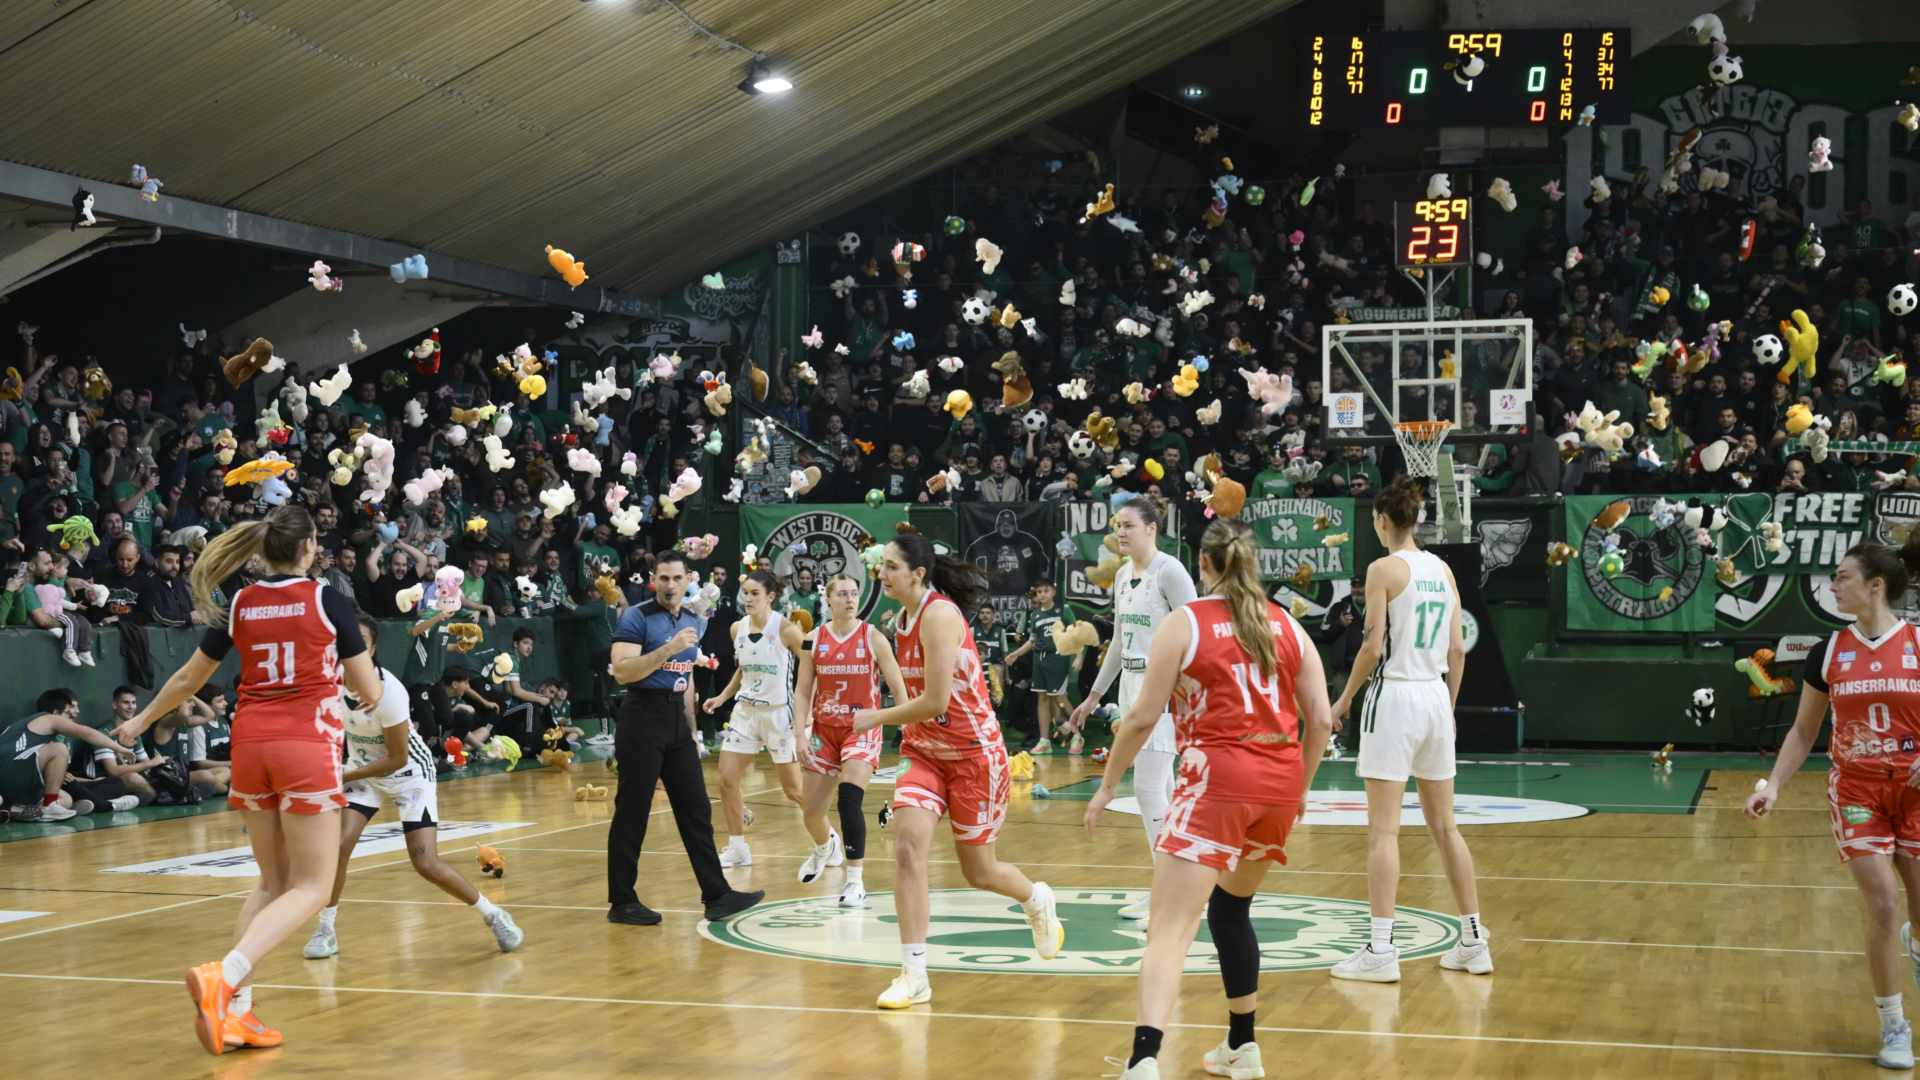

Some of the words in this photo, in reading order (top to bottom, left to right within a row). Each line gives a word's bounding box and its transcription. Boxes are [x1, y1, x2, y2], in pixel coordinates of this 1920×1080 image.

[1313, 37, 1323, 50] 2
[1449, 34, 1501, 56] 9:59
[1563, 33, 1572, 46] 0
[1602, 32, 1613, 46] 15
[1314, 52, 1322, 64] 4
[1352, 51, 1363, 64] 17
[1564, 49, 1572, 60] 4
[1598, 47, 1613, 61] 31
[1347, 66, 1363, 80] 21
[1565, 63, 1572, 75] 7
[1598, 62, 1613, 76] 34
[1409, 68, 1428, 94] 0
[1527, 66, 1546, 92] 0
[1561, 78, 1572, 91] 12
[1599, 77, 1613, 90] 77
[1313, 81, 1322, 95] 8
[1348, 81, 1363, 93] 77
[1310, 96, 1322, 110] 10
[1560, 93, 1572, 106] 13
[1310, 111, 1322, 125] 12
[1386, 103, 1402, 123] 0
[1530, 101, 1546, 121] 0
[1560, 108, 1572, 120] 14
[1416, 199, 1467, 222] 9:59
[1408, 225, 1458, 260] 23
[1241, 498, 1343, 527] ANATHINAIKOS
[1773, 493, 1864, 523] FREE
[771, 515, 817, 549] WEST
[822, 516, 863, 547] BLOC
[1258, 547, 1343, 575] TISSIA
[1415, 581, 1445, 592] VITOLA
[240, 602, 305, 620] PANSERRAIKOS
[1414, 601, 1445, 648] 17
[251, 641, 295, 685] 31
[751, 680, 762, 692] 2
[1231, 663, 1280, 714] 14
[1868, 703, 1891, 732] 0
